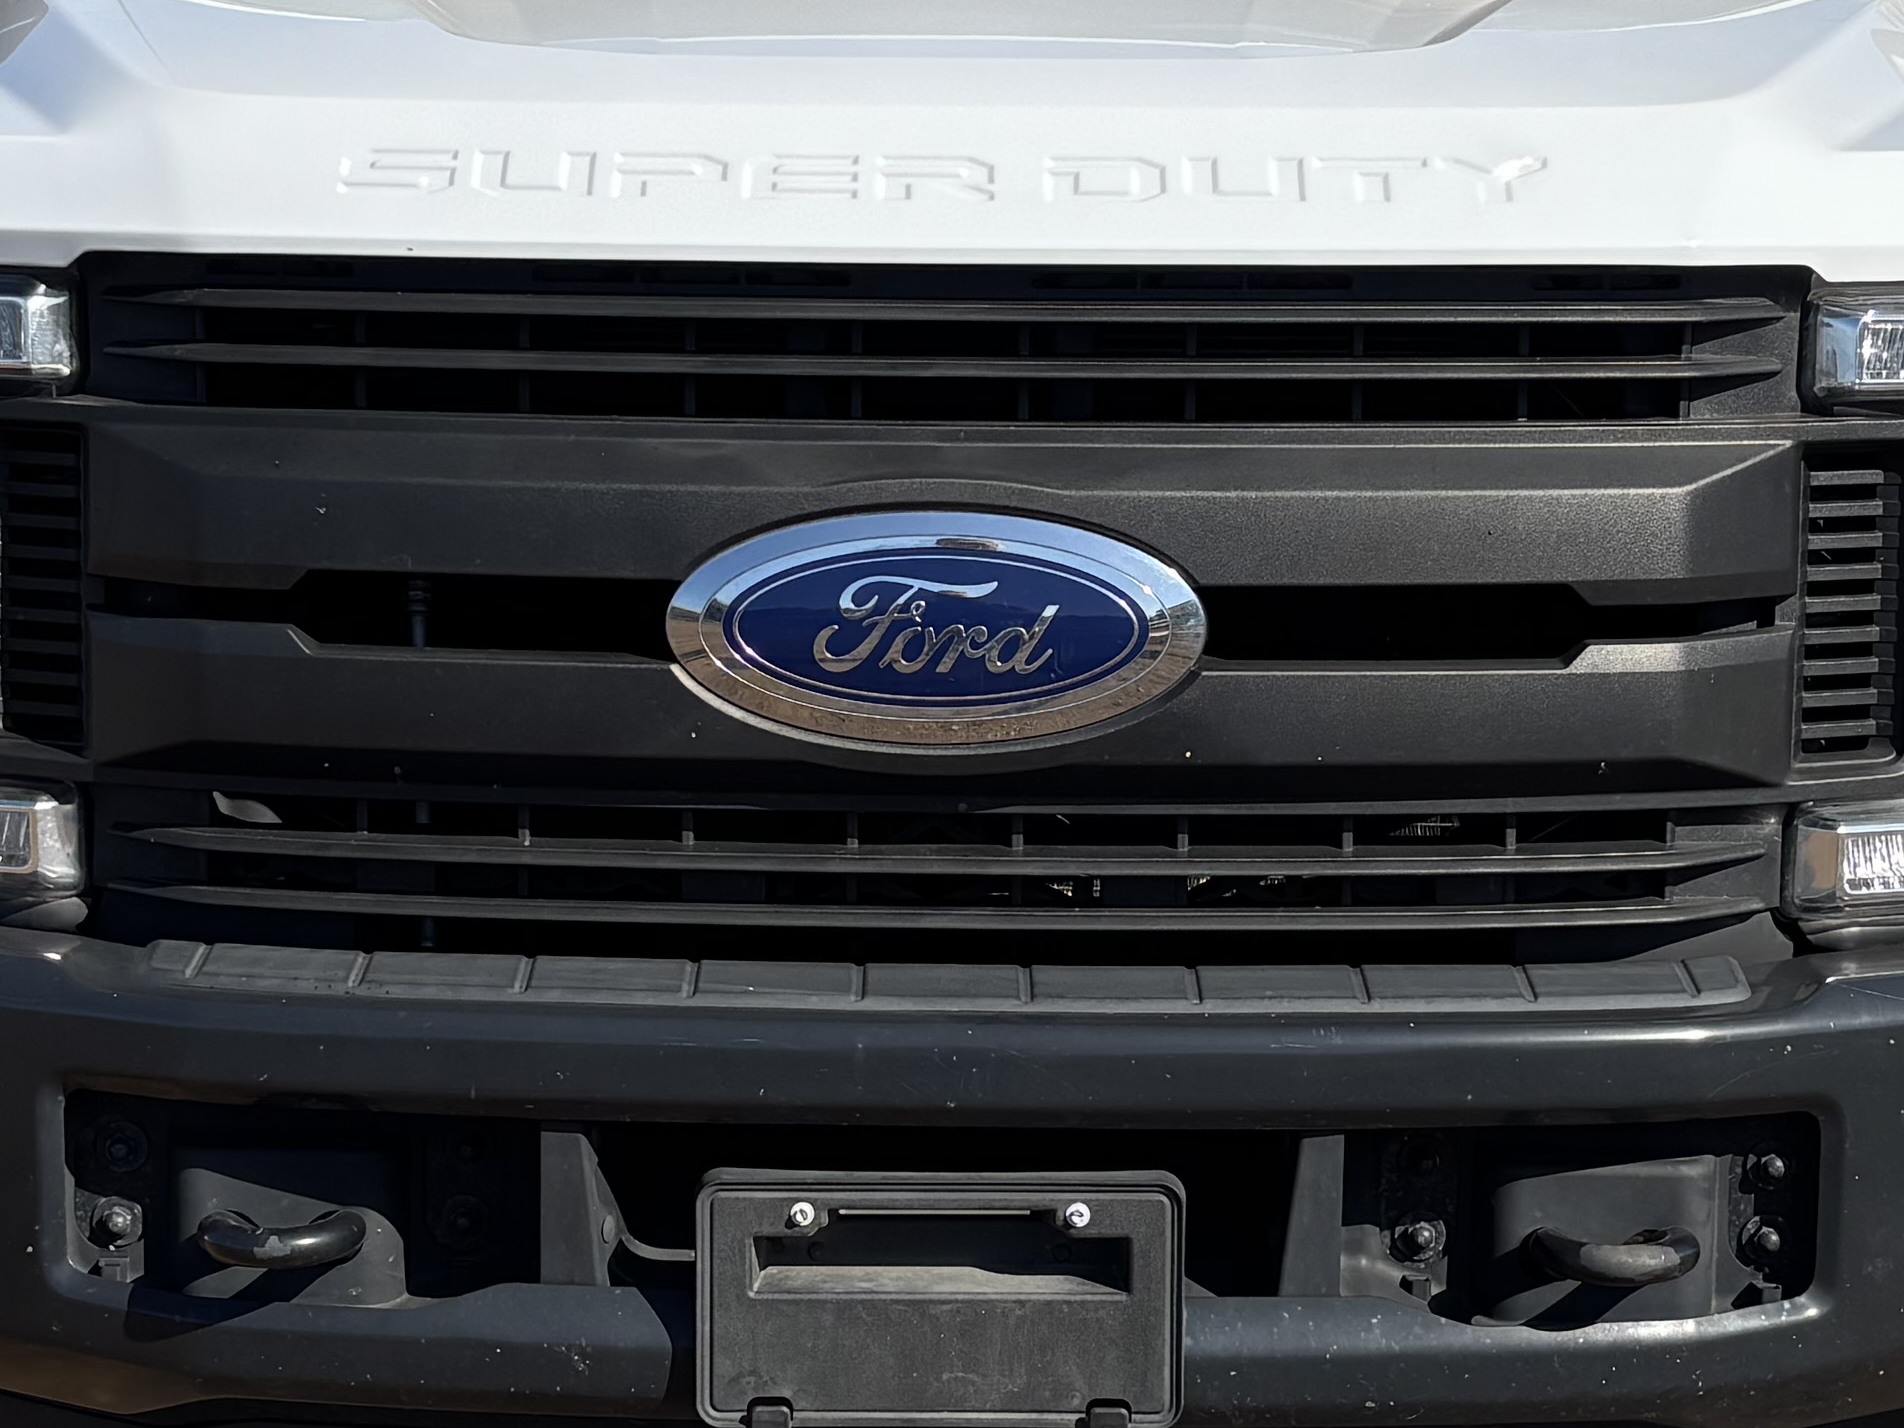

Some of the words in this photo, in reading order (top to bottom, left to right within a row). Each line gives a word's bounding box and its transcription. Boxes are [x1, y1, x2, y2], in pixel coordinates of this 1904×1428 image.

[339, 148, 996, 203] SUPER
[1042, 155, 1548, 204] DUTY
[812, 574, 1059, 675] Ford
